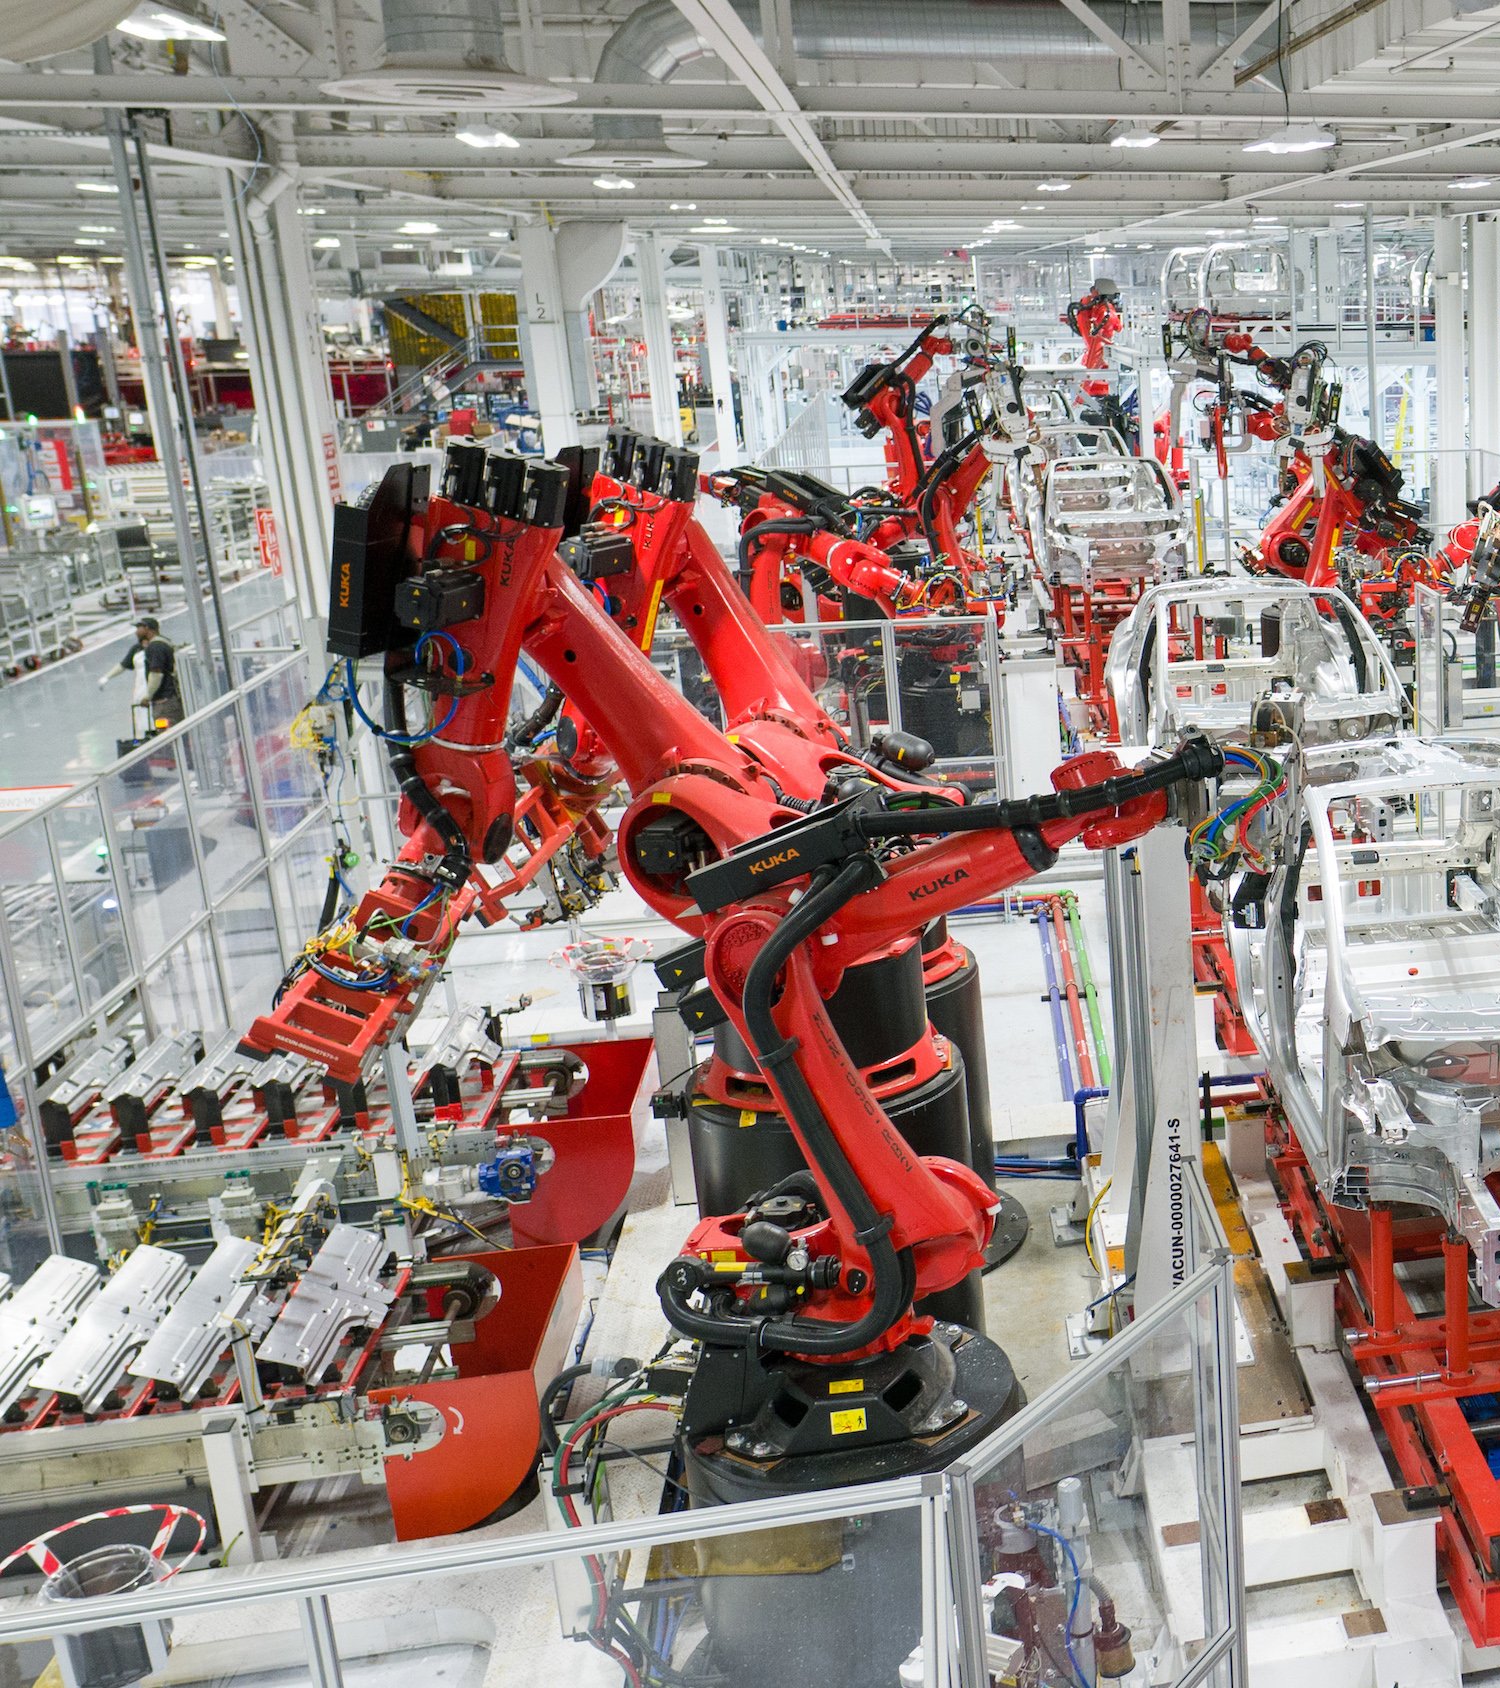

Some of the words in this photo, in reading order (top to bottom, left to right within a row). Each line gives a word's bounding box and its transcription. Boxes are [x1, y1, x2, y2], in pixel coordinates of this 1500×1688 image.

[536, 293, 544, 305] L
[1325, 286, 1333, 294] M
[537, 307, 545, 320] 2
[783, 489, 798, 501] KUKA
[500, 540, 515, 588] KUKA
[340, 562, 351, 608] KUKA
[749, 848, 800, 875] KUKA
[908, 868, 970, 901] KUKA
